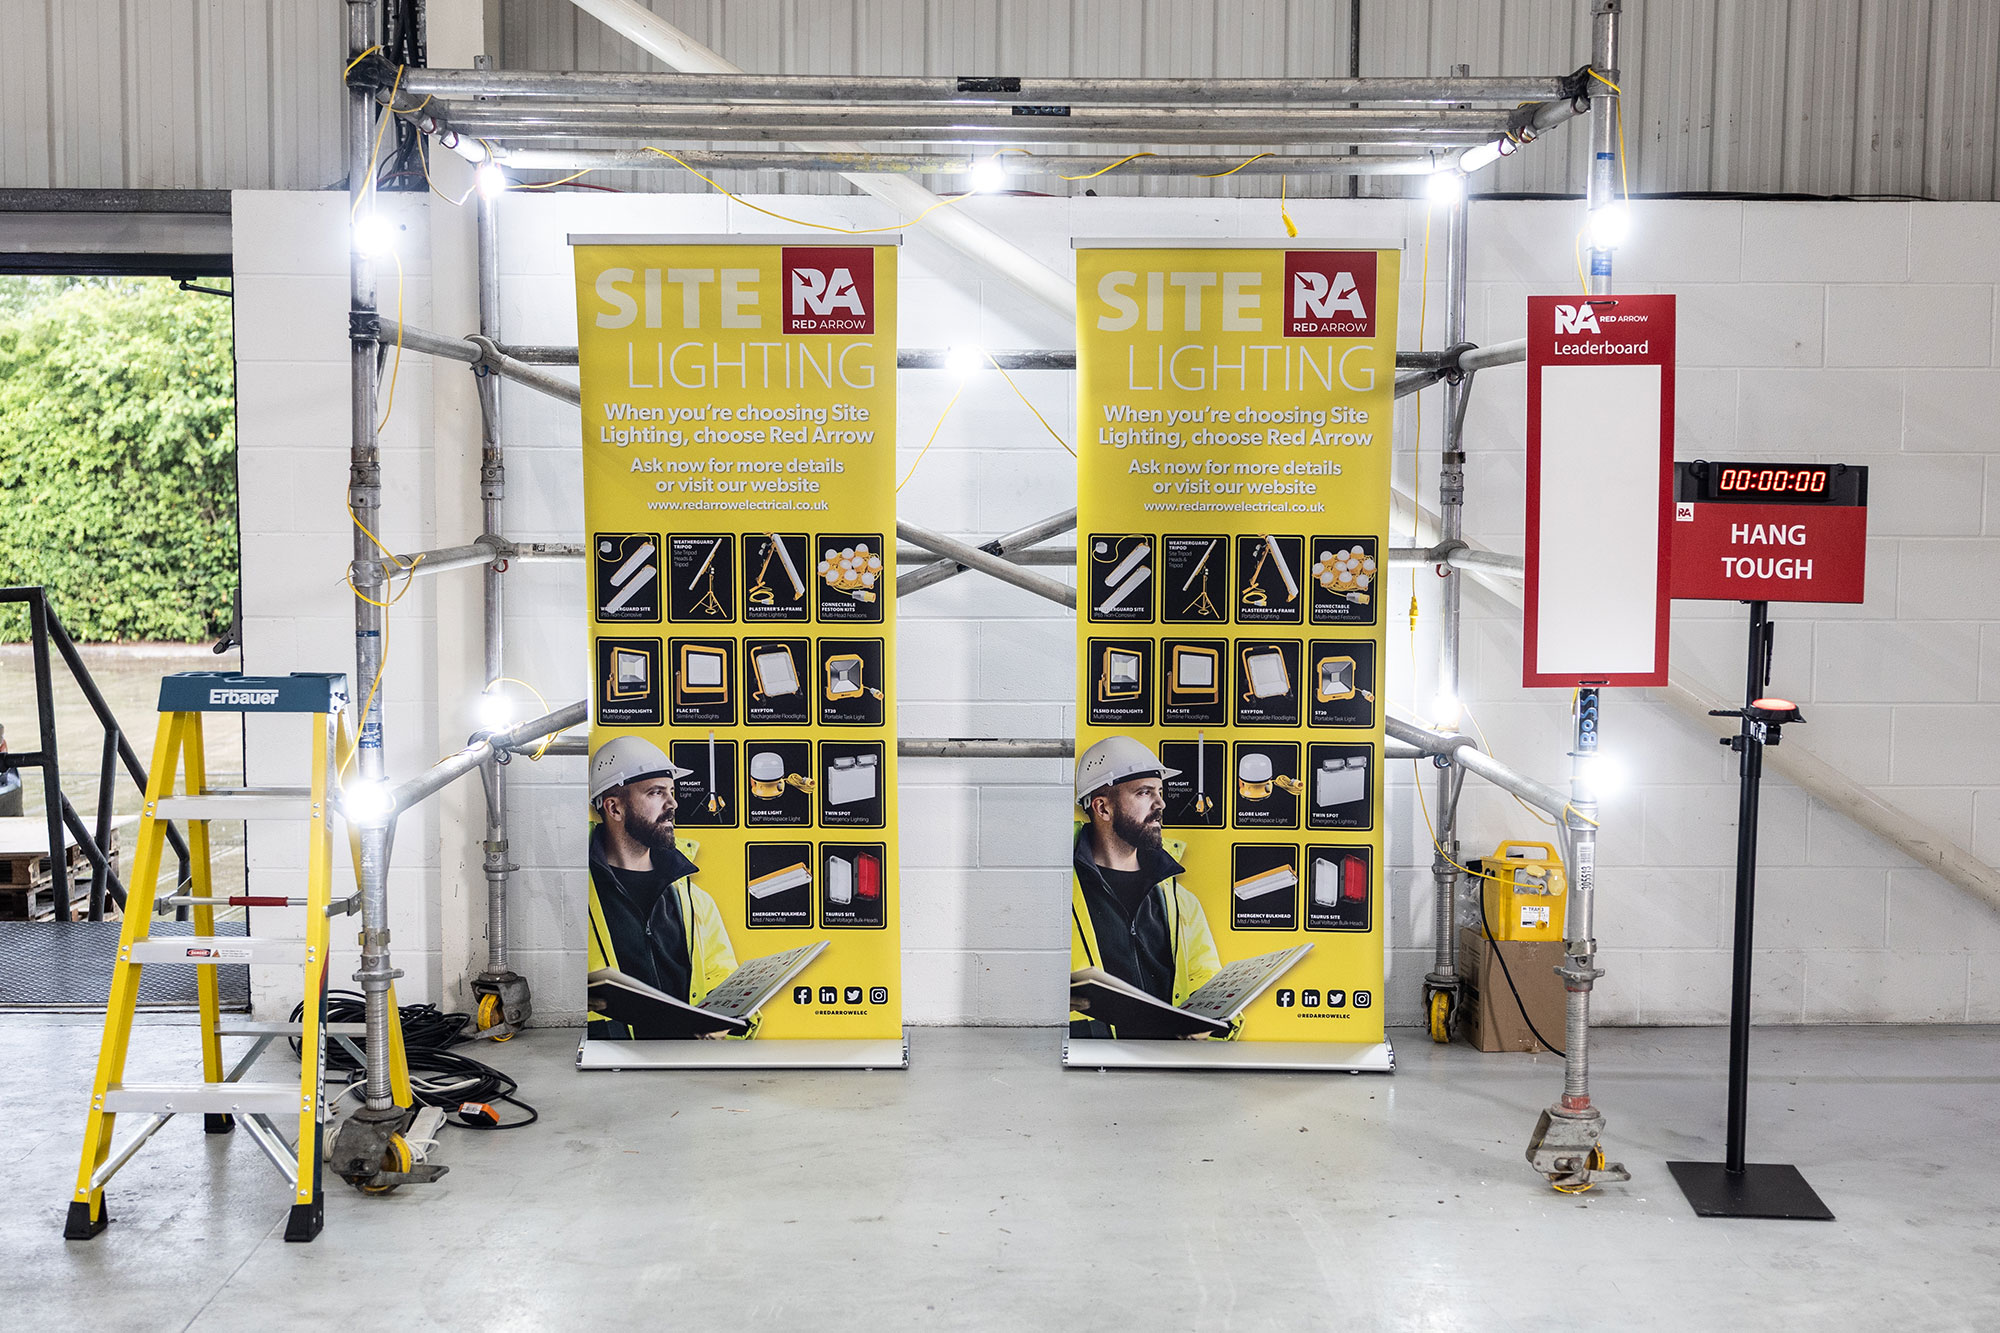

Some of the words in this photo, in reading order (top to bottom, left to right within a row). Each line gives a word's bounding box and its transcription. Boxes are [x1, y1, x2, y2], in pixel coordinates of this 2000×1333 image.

[595, 267, 762, 329] SITE
[791, 268, 866, 315] RA
[1097, 271, 1263, 332] SITE
[1293, 271, 1367, 318] RA
[792, 320, 817, 329] RED
[819, 320, 866, 329] ARROW
[1293, 323, 1318, 333] RED
[1320, 323, 1367, 333] ARROW
[1554, 304, 1601, 335] RA
[1554, 340, 1649, 355] Leaderboard
[628, 342, 875, 389] LIGHTING
[1129, 345, 1375, 391] LIGHTING
[604, 403, 664, 421] When
[736, 404, 827, 425] choosing
[831, 404, 869, 421] Site
[1103, 405, 1163, 422] When
[1234, 405, 1326, 427] choosing
[1330, 406, 1368, 424] Site
[600, 427, 689, 447] Lighting,
[694, 427, 765, 443] choose
[770, 427, 808, 443] Red
[811, 427, 874, 443] Arrow
[1099, 428, 1187, 448] Lighting,
[1191, 429, 1263, 445] choose
[1267, 429, 1304, 445] Red
[1309, 430, 1373, 446] Arrow
[630, 457, 663, 473] Ask
[666, 462, 705, 473] now
[708, 458, 733, 473] for
[737, 462, 782, 473] more
[785, 458, 845, 473] details
[1128, 459, 1161, 474] Ask
[1164, 463, 1202, 474] now
[1205, 459, 1230, 474] for
[1234, 464, 1280, 475] more
[1283, 460, 1342, 475] details
[655, 481, 676, 493] or
[680, 477, 713, 493] visit
[717, 481, 747, 493] our
[751, 477, 819, 493] website
[1153, 483, 1172, 494] or
[1175, 479, 1211, 494] visit
[1213, 483, 1243, 494] our
[1247, 479, 1316, 495] website
[1720, 469, 1826, 492] 00:00:00
[647, 499, 828, 511] www.redarrowelectrical.co.uk
[1144, 501, 1325, 513] www.redarrowelectrical.co.uk
[1731, 523, 1806, 546] HANG
[1721, 557, 1813, 580] TOUGH
[209, 689, 279, 705] Erbauer
[821, 989, 835, 1002] in
[1304, 993, 1317, 1006] in
